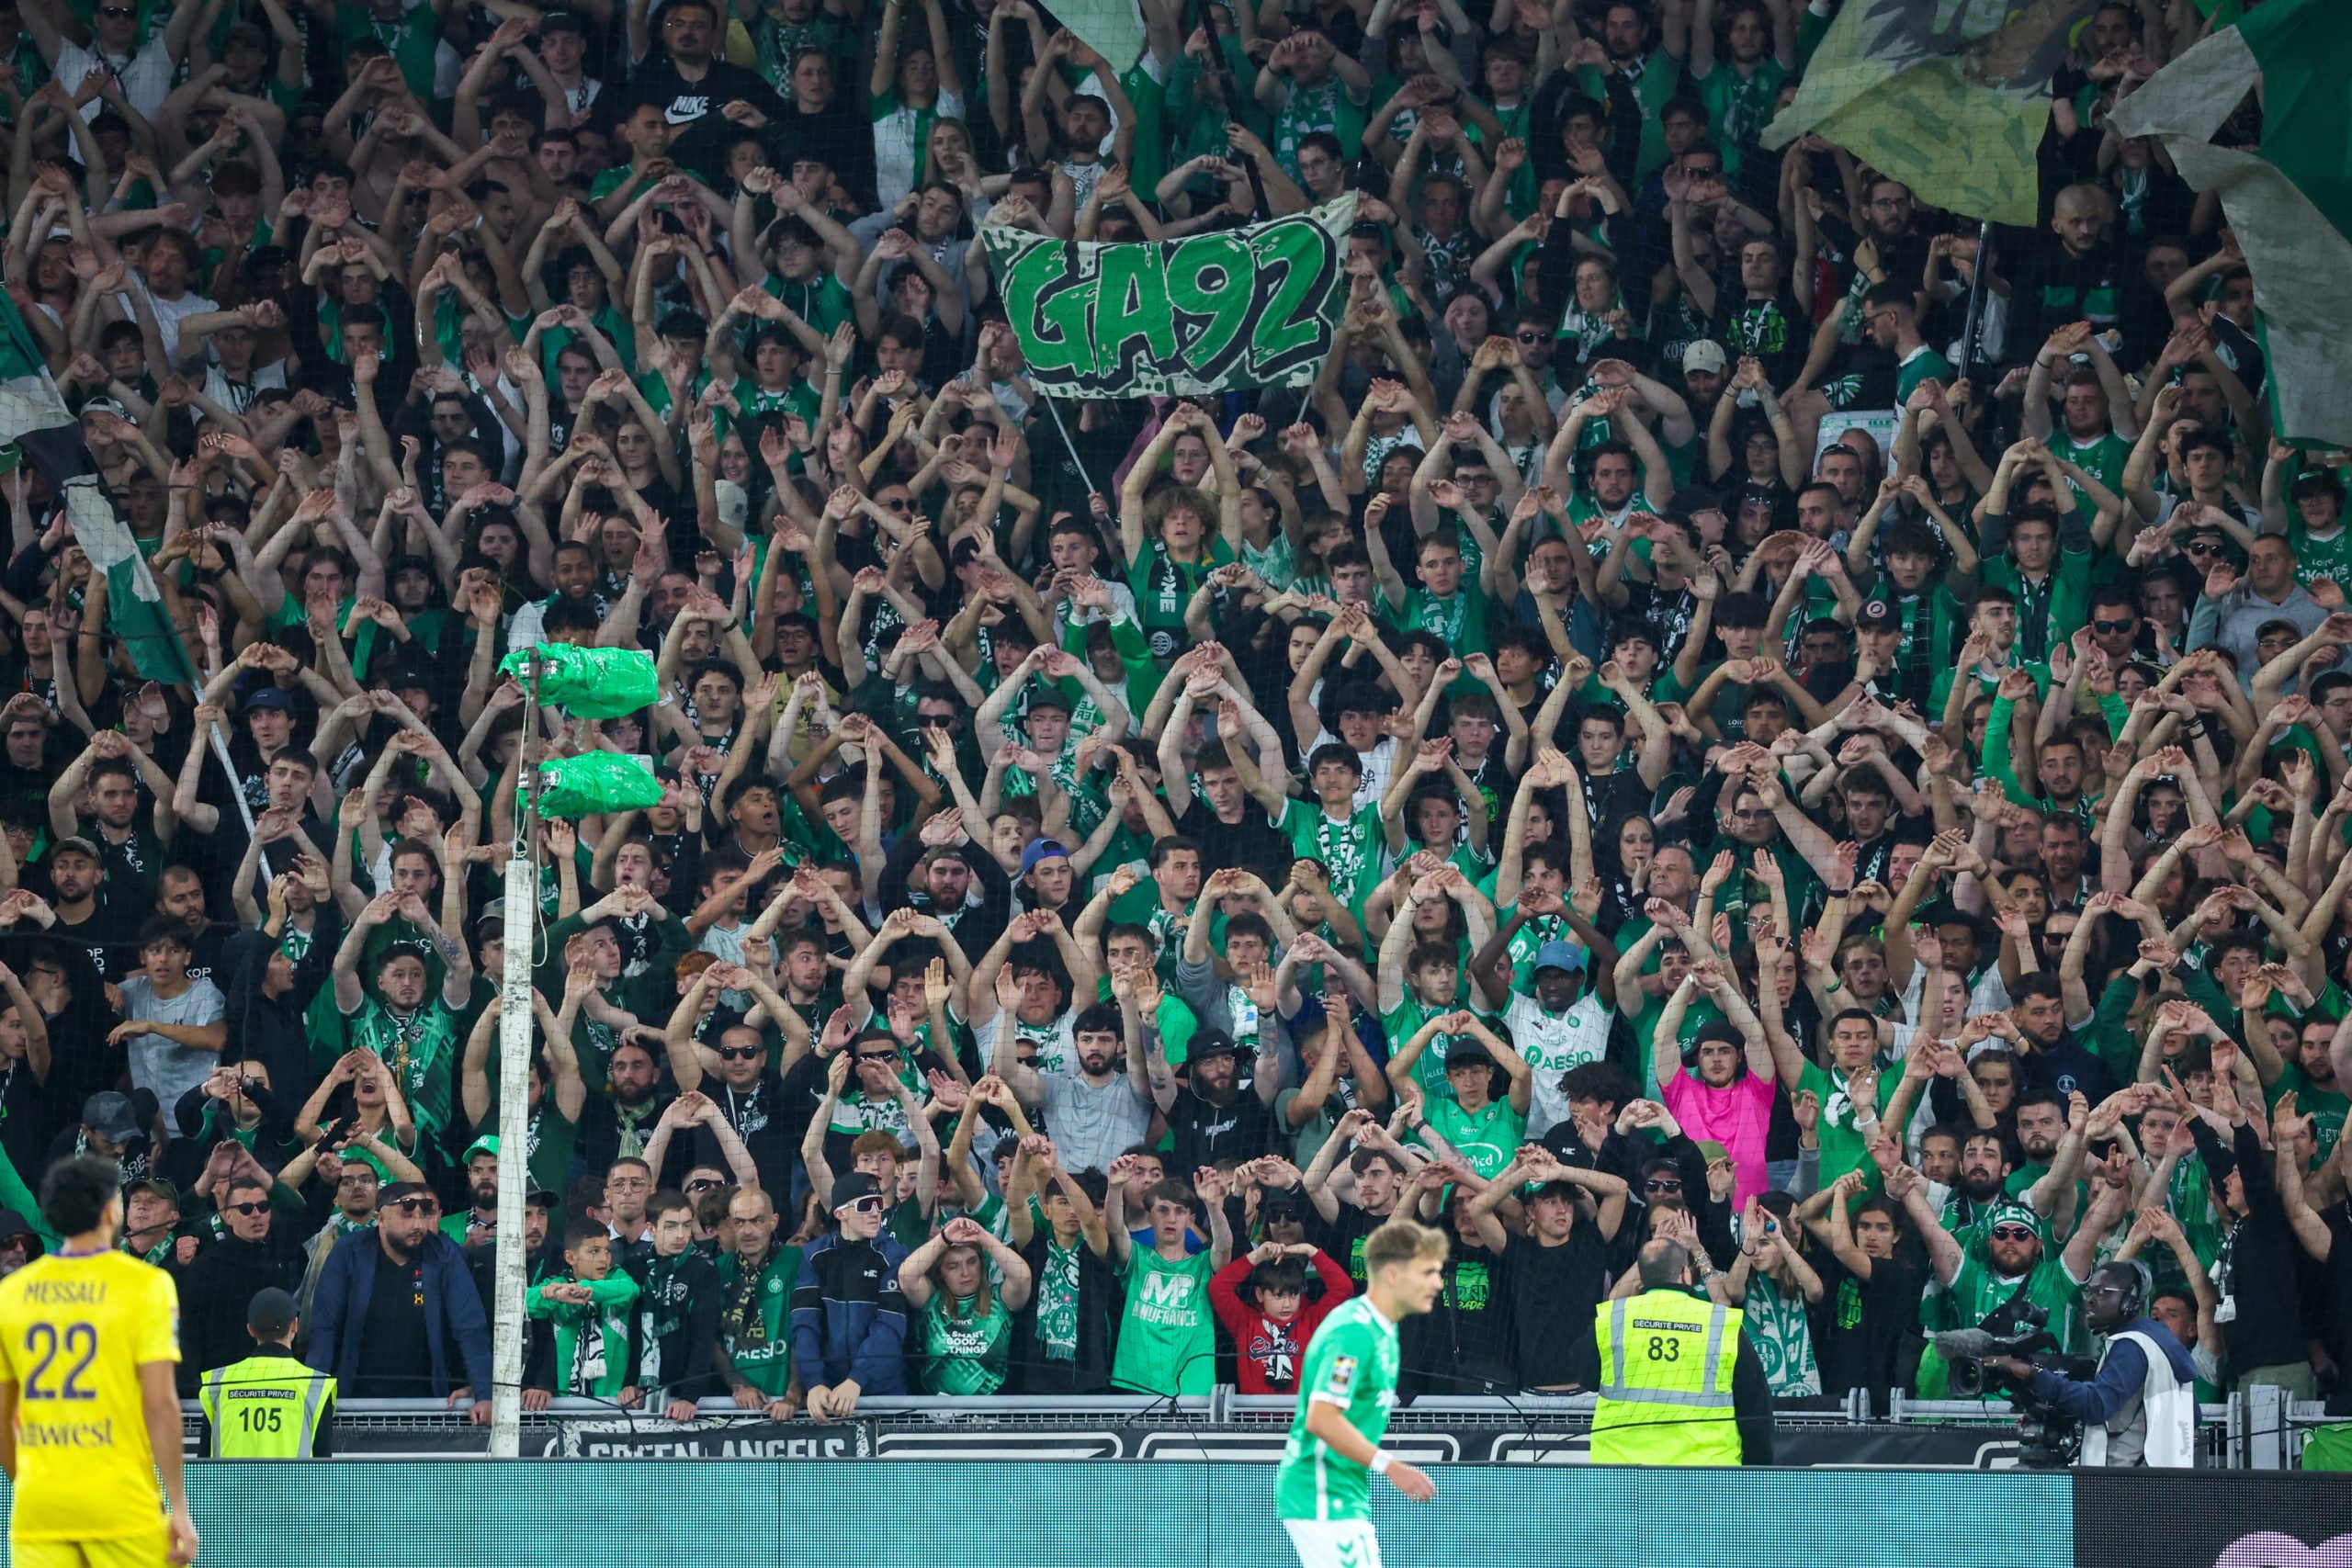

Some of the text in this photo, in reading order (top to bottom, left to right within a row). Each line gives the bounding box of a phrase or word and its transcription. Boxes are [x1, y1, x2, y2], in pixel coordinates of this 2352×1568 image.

[673, 96, 709, 113] NIKE
[997, 215, 1339, 384] GA92
[1994, 1205, 2035, 1226] LES
[24, 1281, 107, 1305] MESSALI
[946, 1337, 976, 1346] GOOD
[952, 1330, 985, 1339] SMART
[949, 1345, 988, 1355] THINGS
[1647, 1337, 1679, 1362] 83
[25, 1323, 98, 1402] 22
[239, 1406, 281, 1433] 105
